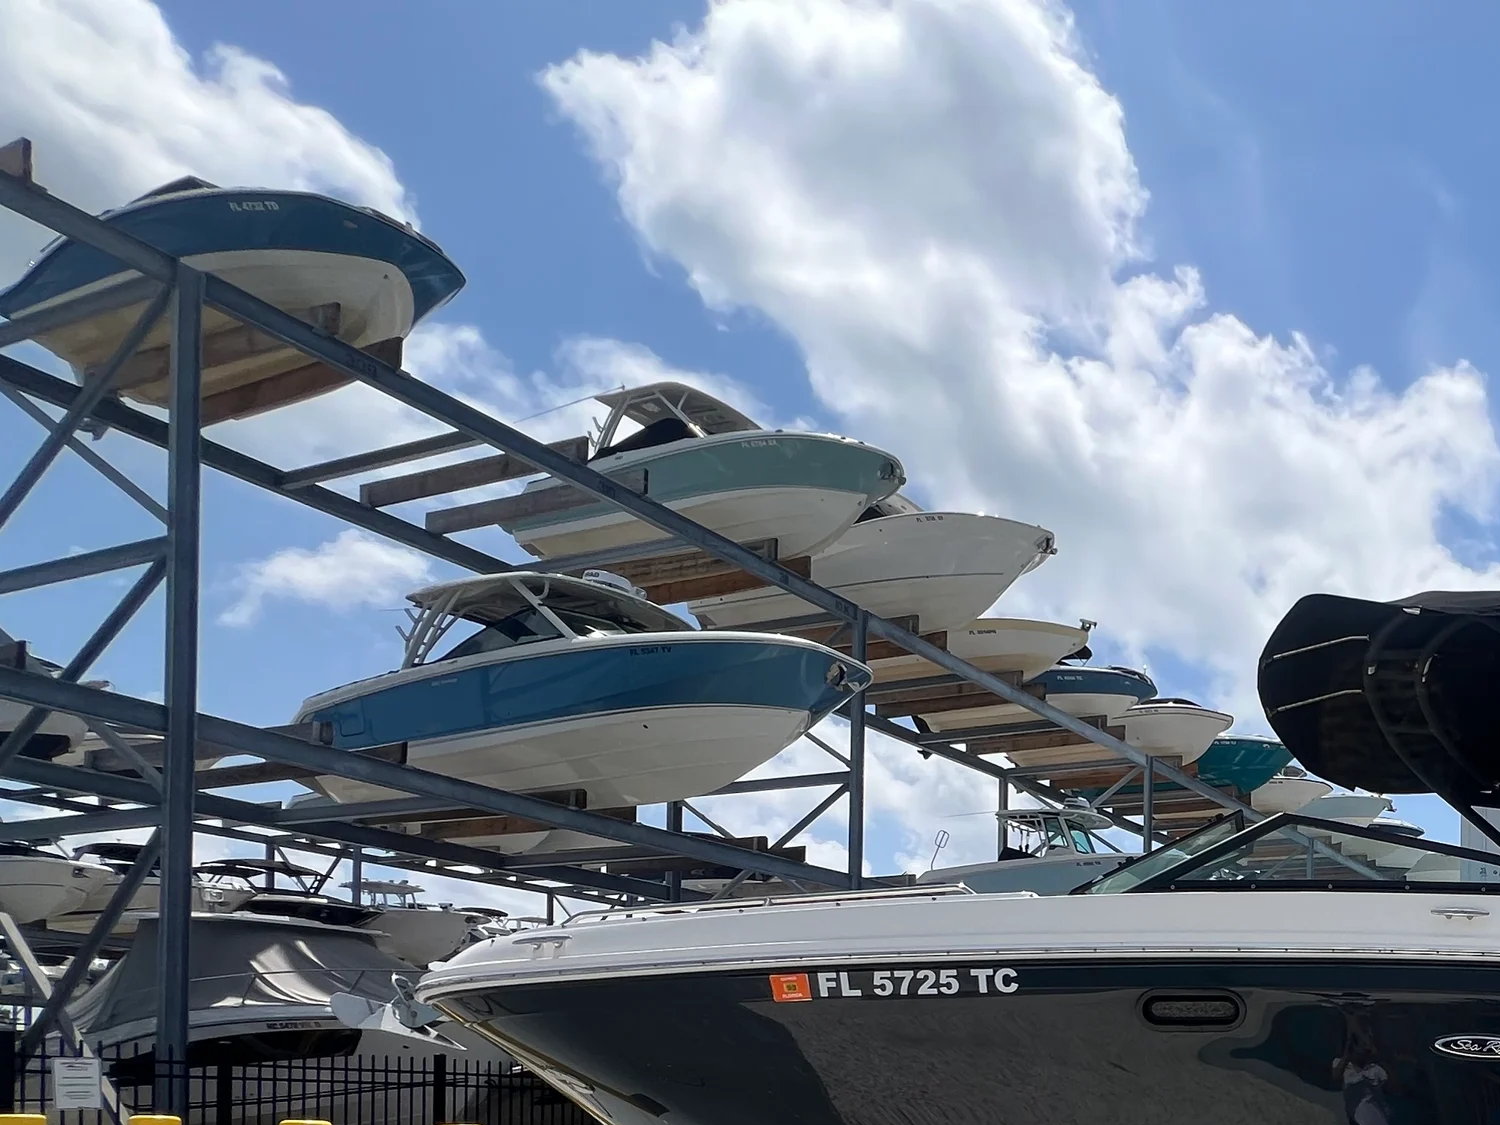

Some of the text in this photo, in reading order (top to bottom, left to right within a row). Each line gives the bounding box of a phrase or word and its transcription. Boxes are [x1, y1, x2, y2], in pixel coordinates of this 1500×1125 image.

[818, 967, 1020, 998] FL 5725 TC
[1450, 1039, 1482, 1052] Sea
